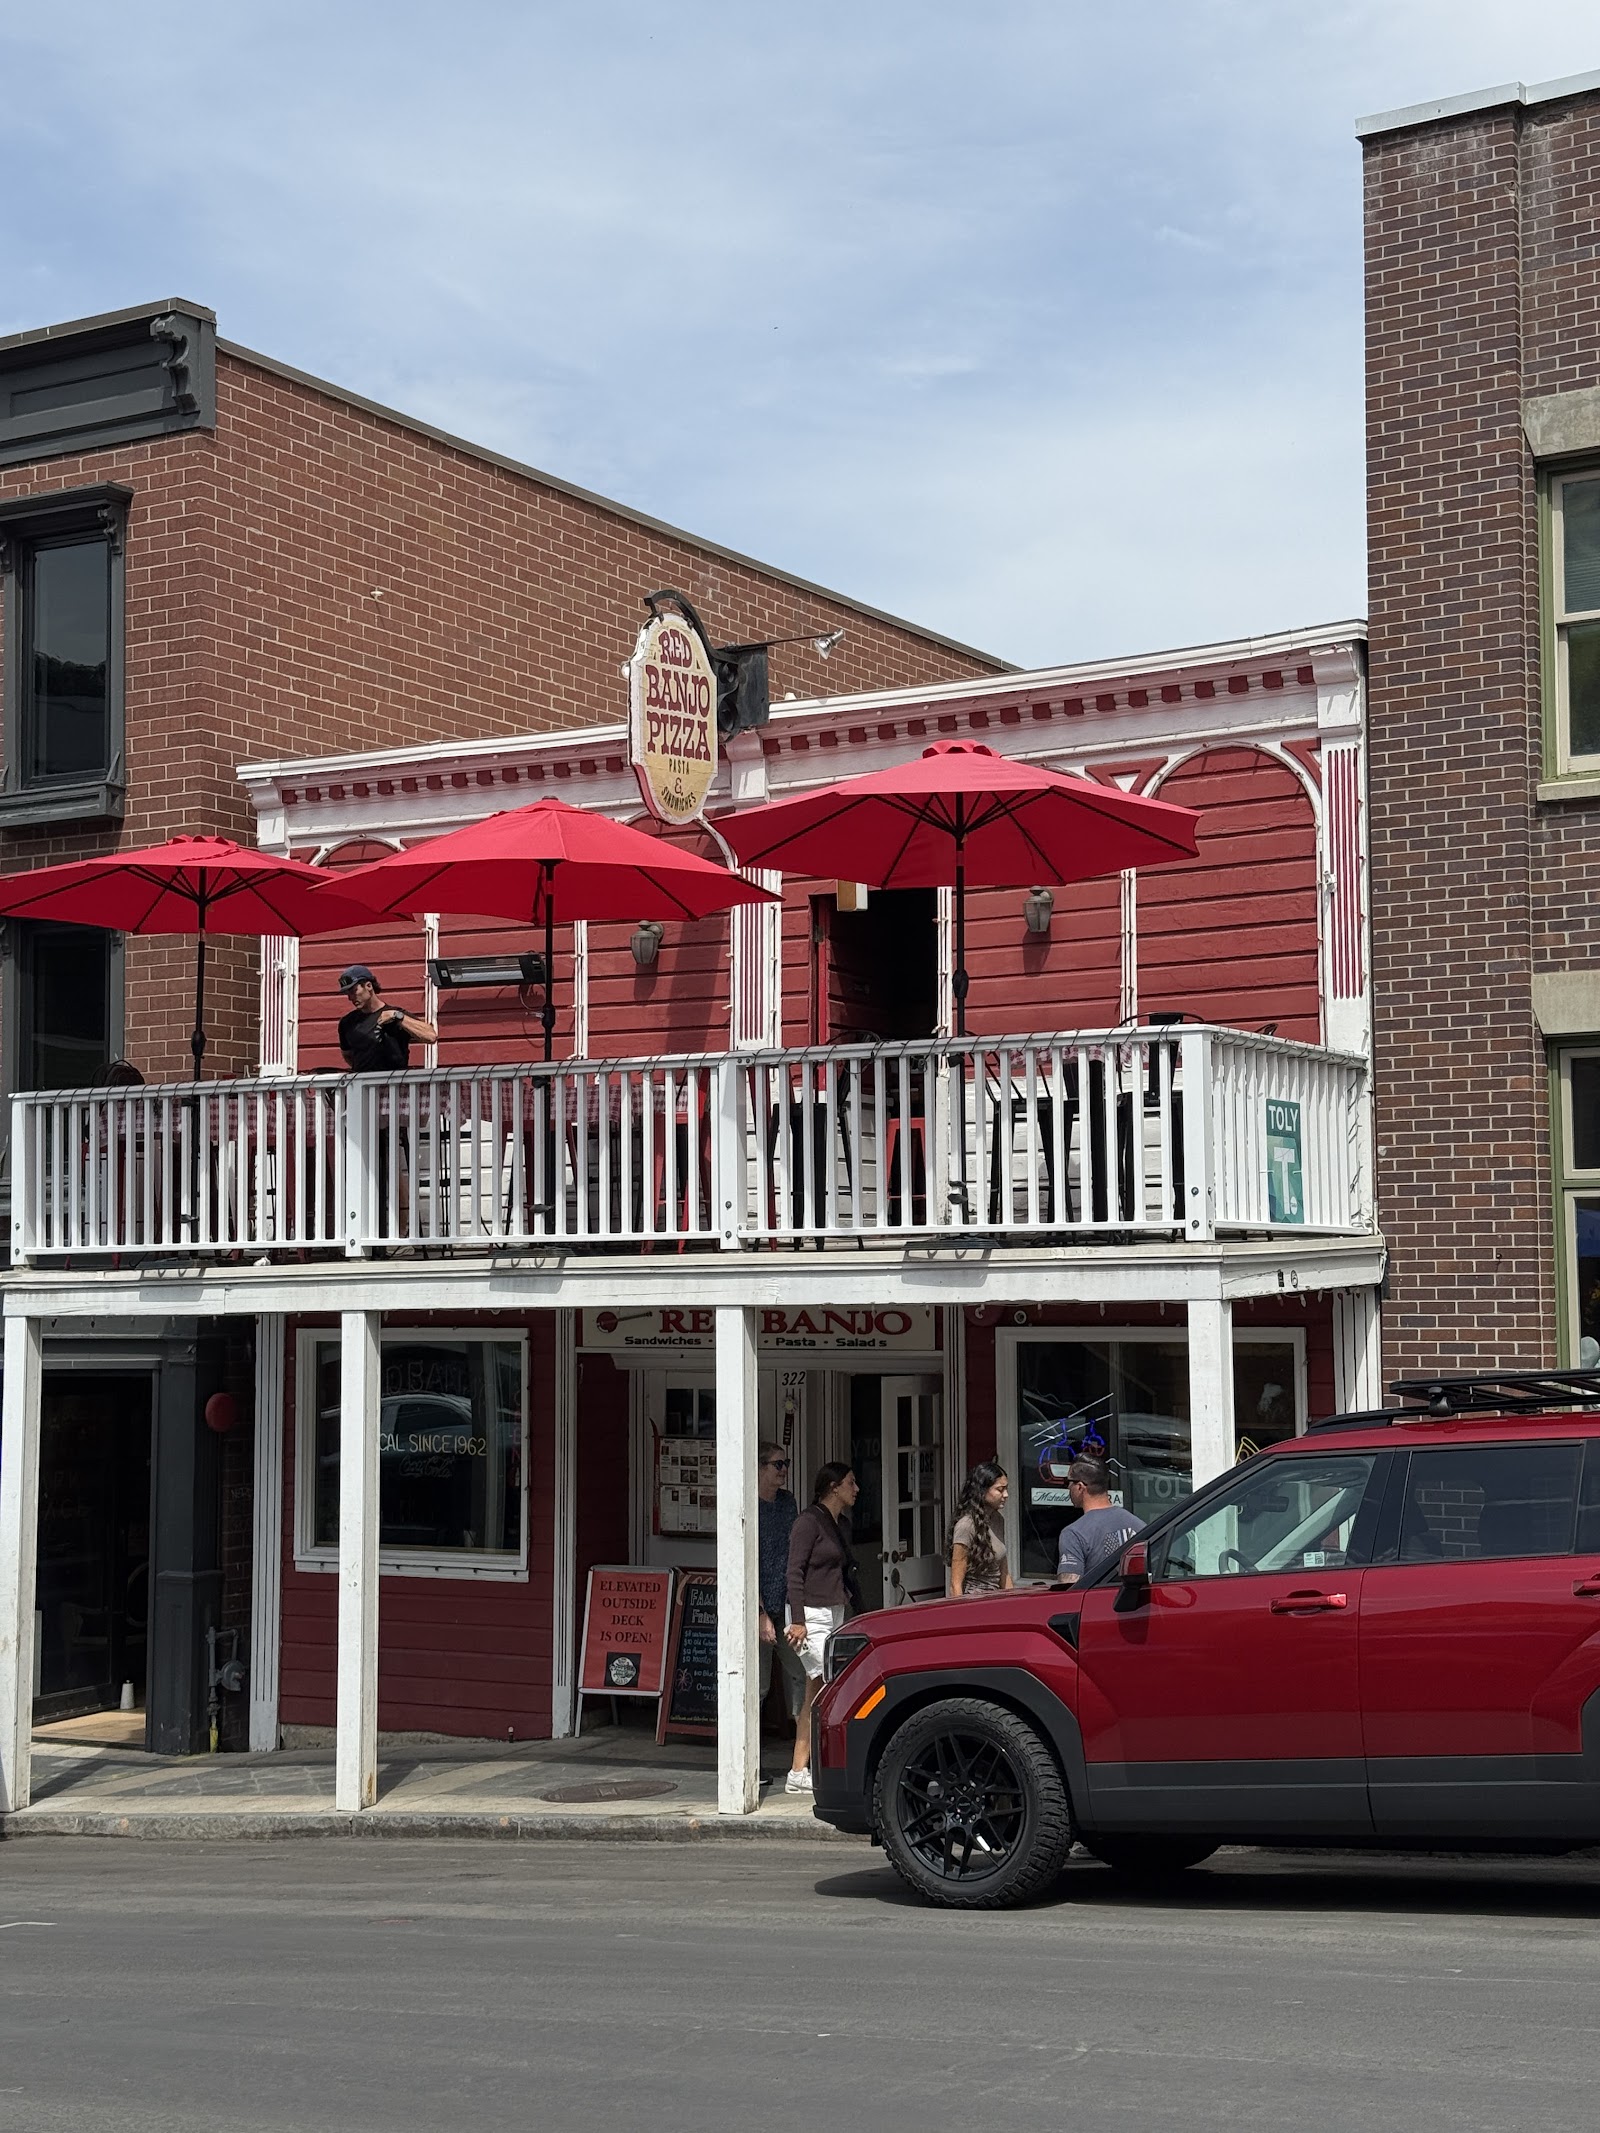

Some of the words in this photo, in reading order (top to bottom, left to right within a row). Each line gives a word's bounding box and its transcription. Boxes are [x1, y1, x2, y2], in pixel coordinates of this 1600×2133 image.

[658, 629, 693, 667] RED
[645, 665, 711, 718] BANJO
[646, 711, 711, 761] PIZZA
[668, 757, 690, 775] PASTA
[661, 786, 697, 812] SANDWICHES
[1268, 1105, 1299, 1132] TOLY
[659, 1309, 715, 1334] RE
[760, 1310, 912, 1336] BANJO
[624, 1336, 701, 1345] Sandwiches
[775, 1337, 816, 1347] Pasta
[781, 1371, 806, 1386] 322
[1139, 1475, 1190, 1499] TOL
[599, 1580, 661, 1594] ELEVATED
[601, 1597, 657, 1610] OUTSIDE
[611, 1615, 645, 1627] DECK
[600, 1631, 613, 1642] IS
[614, 1632, 653, 1644] OPEN!
